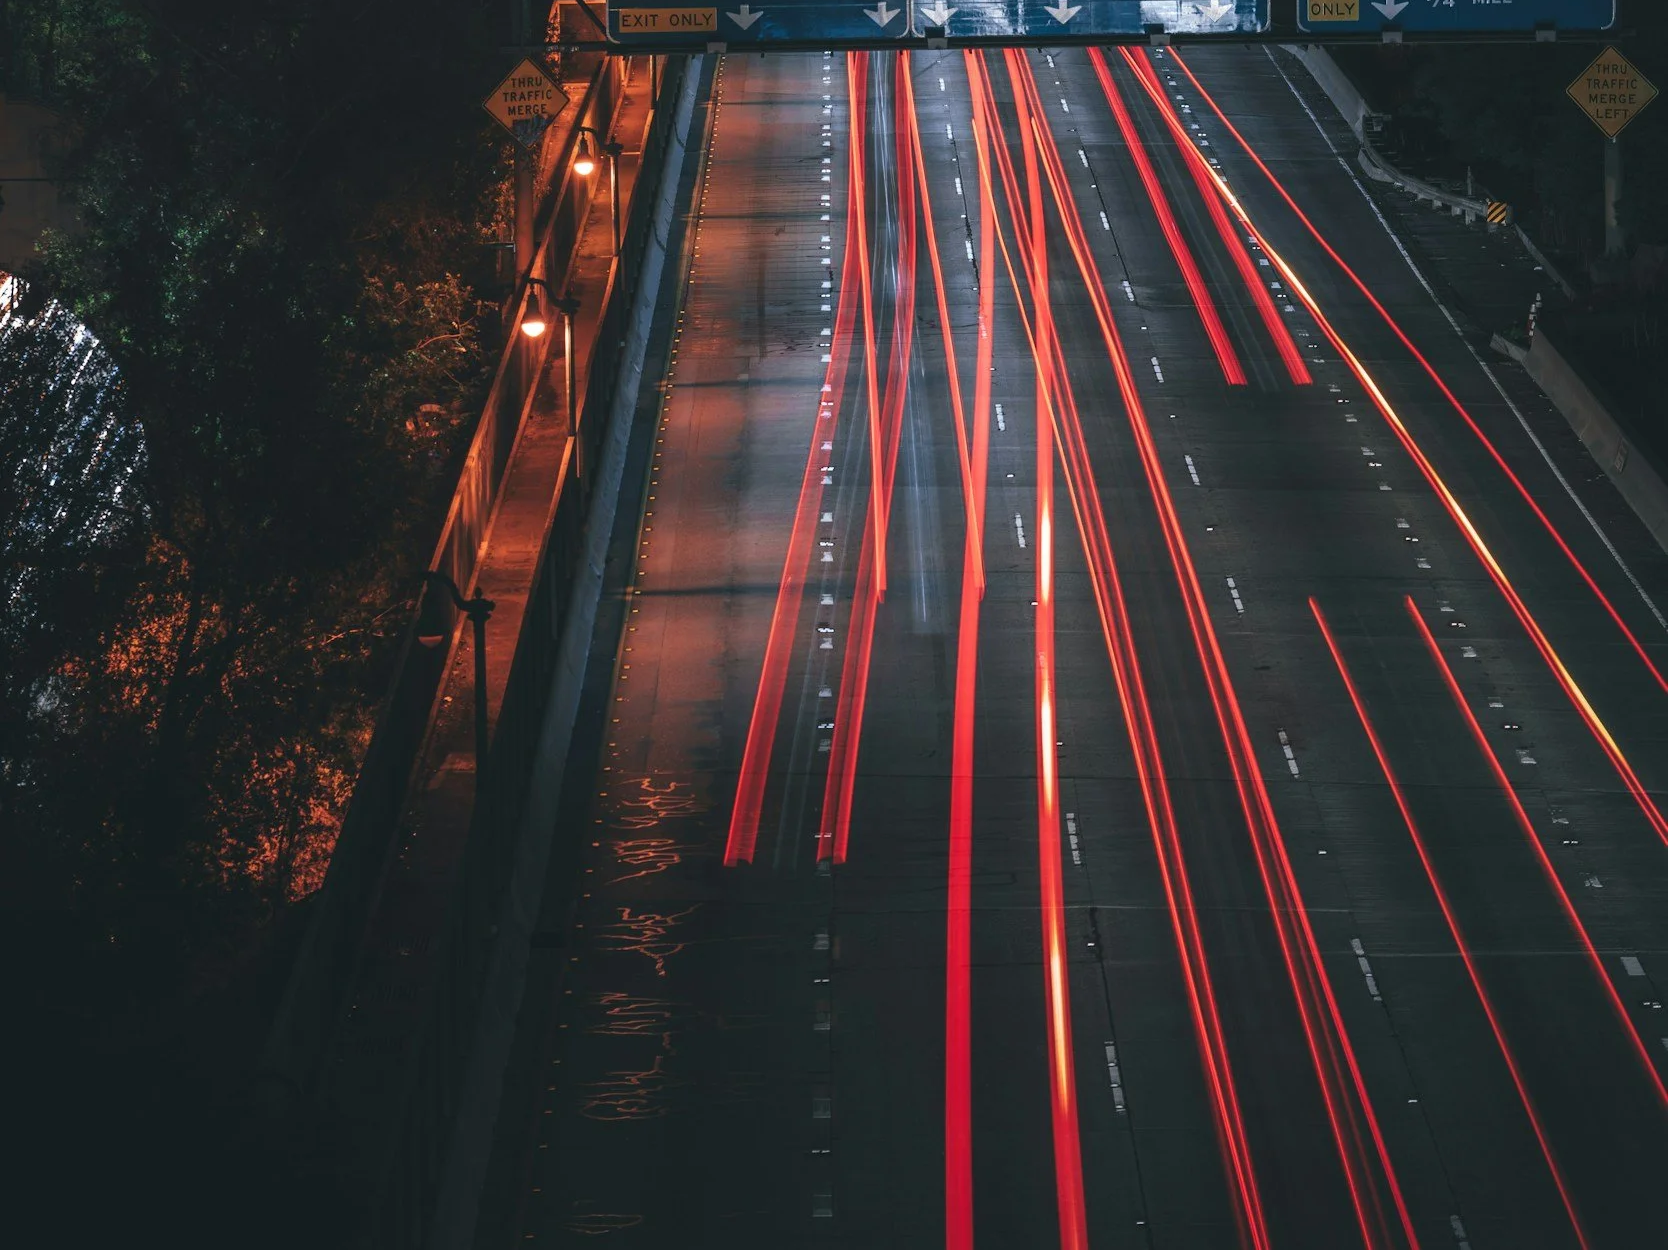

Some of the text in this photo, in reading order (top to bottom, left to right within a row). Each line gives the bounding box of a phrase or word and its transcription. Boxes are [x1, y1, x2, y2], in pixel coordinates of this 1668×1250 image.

[1311, 3, 1356, 16] ONLY
[621, 12, 714, 28] EXIT ONLY
[1596, 64, 1628, 75] THRU
[511, 76, 542, 88] THRU
[1586, 78, 1638, 89] TRAFFIC
[503, 90, 553, 102] TRAFFIC
[1588, 93, 1637, 104] MERGE
[507, 103, 548, 116] MERGE
[1596, 108, 1630, 119] LEFT
